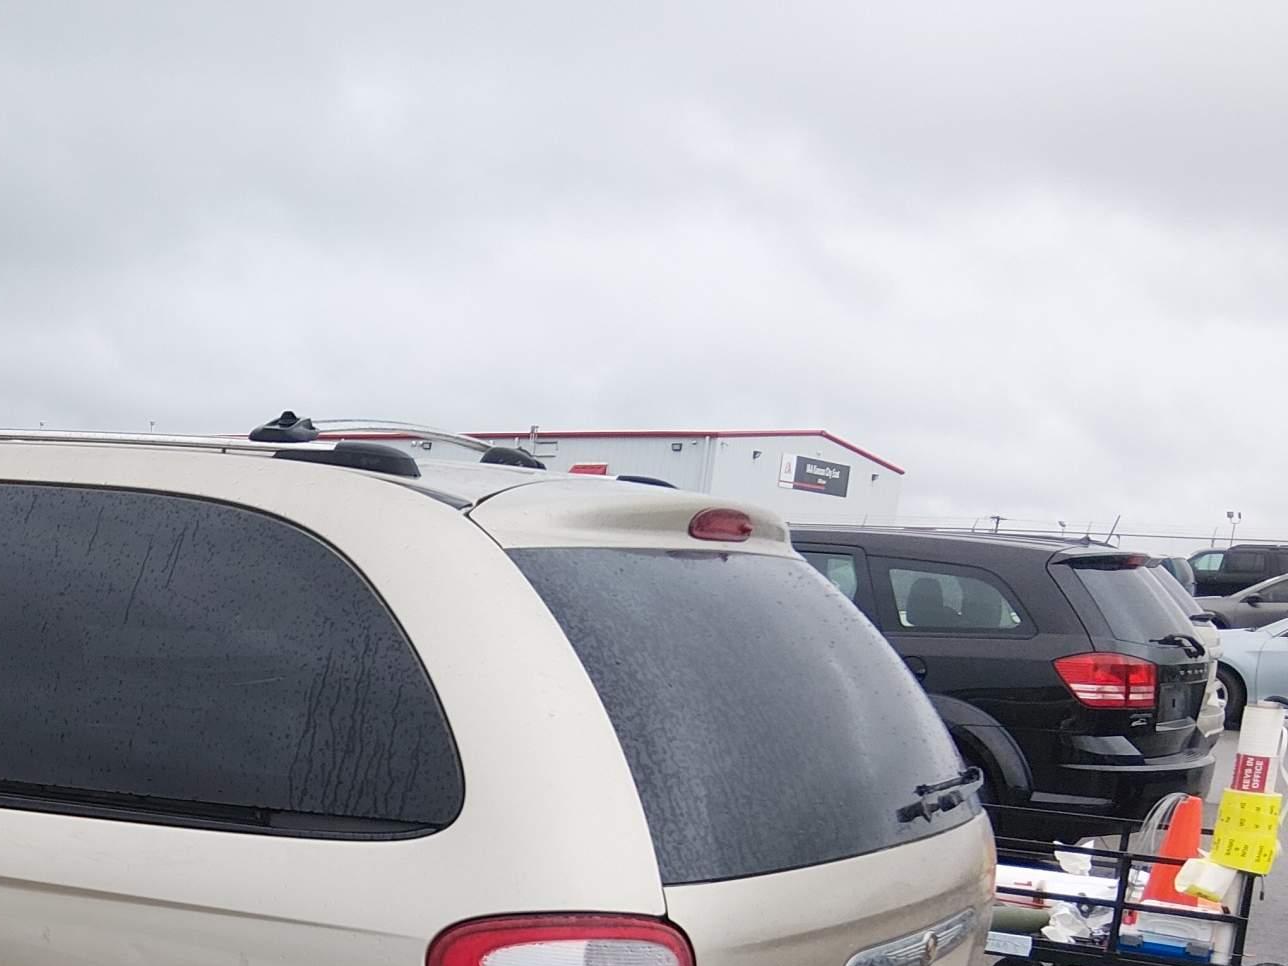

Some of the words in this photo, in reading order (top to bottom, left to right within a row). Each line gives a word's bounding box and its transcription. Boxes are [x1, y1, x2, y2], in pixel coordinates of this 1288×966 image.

[1245, 757, 1255, 767] IN
[1241, 768, 1253, 790] KEYS
[1252, 760, 1264, 789] OFFICE
